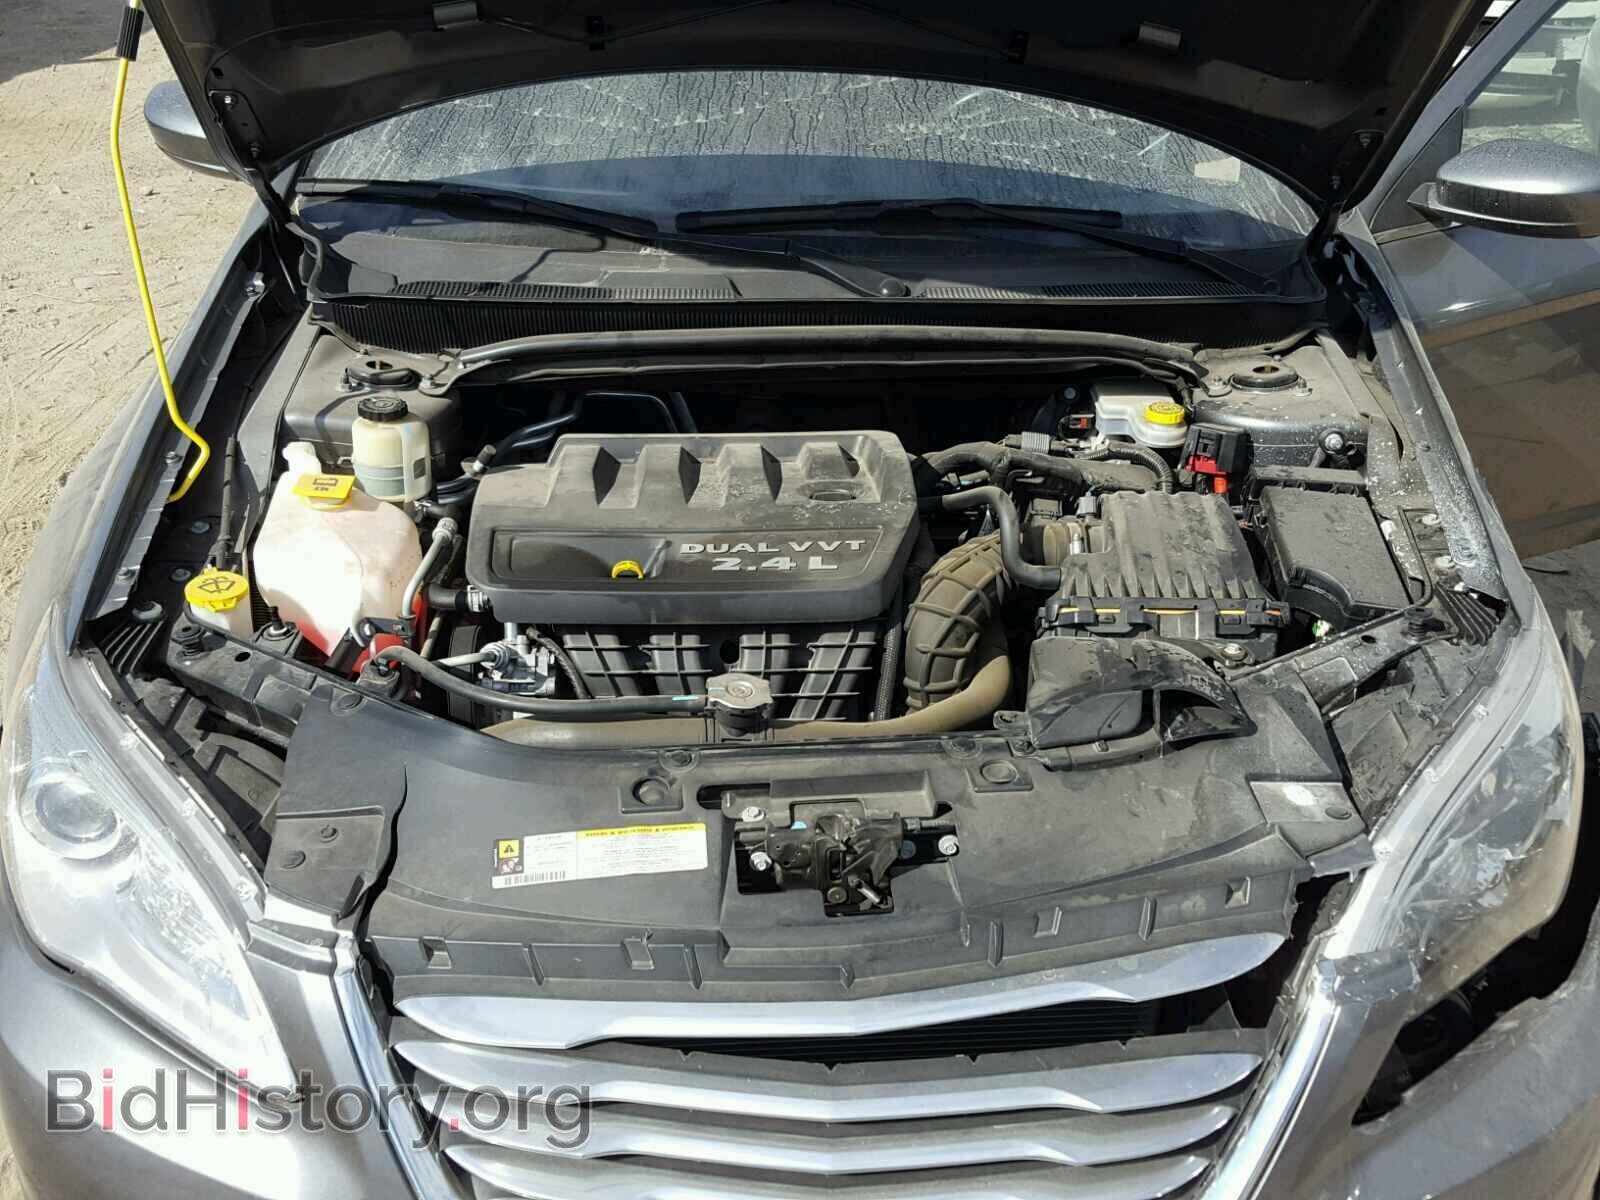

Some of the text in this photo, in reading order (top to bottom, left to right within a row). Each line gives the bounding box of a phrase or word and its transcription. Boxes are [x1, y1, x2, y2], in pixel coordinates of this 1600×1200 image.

[680, 540, 866, 554] DUAL VVT
[712, 556, 838, 571] 2.4 L
